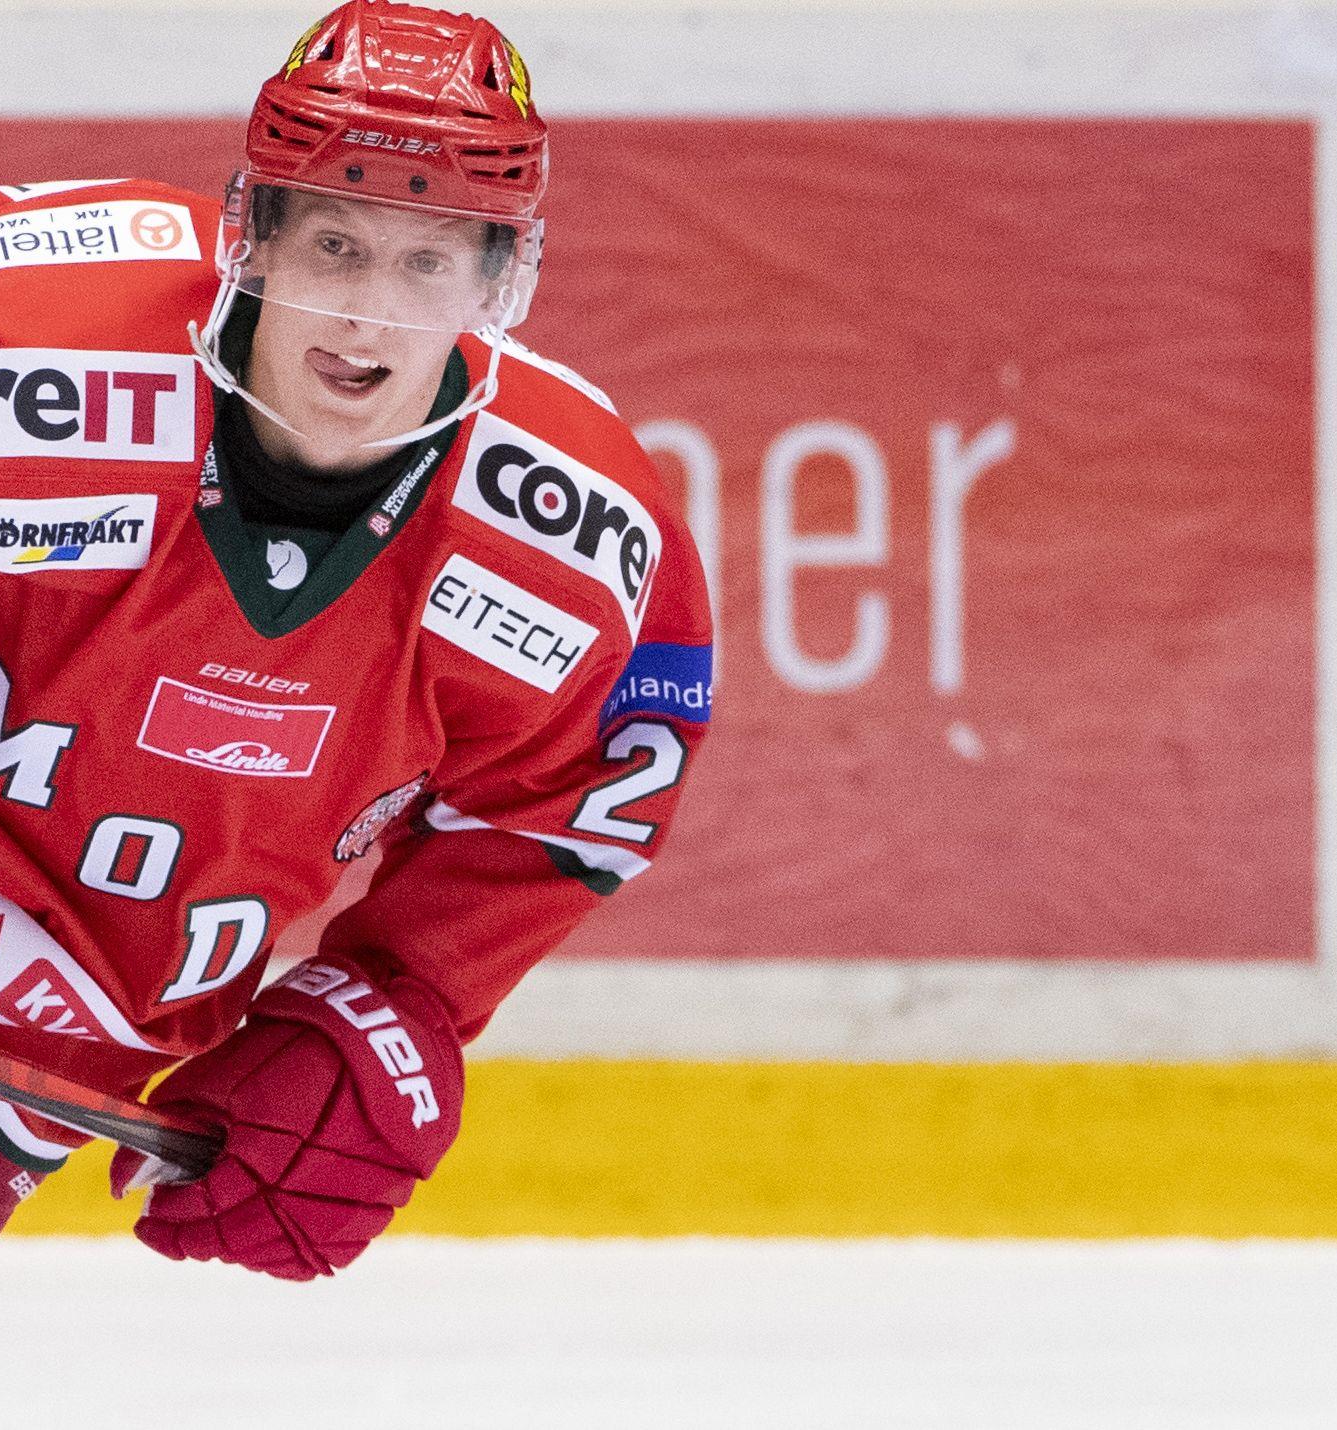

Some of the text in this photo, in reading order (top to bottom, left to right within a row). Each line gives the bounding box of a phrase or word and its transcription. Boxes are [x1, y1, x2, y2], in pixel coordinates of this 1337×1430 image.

[75, 208, 112, 220] TAK
[184, 692, 208, 706] Linde
[185, 741, 290, 771] Linde
